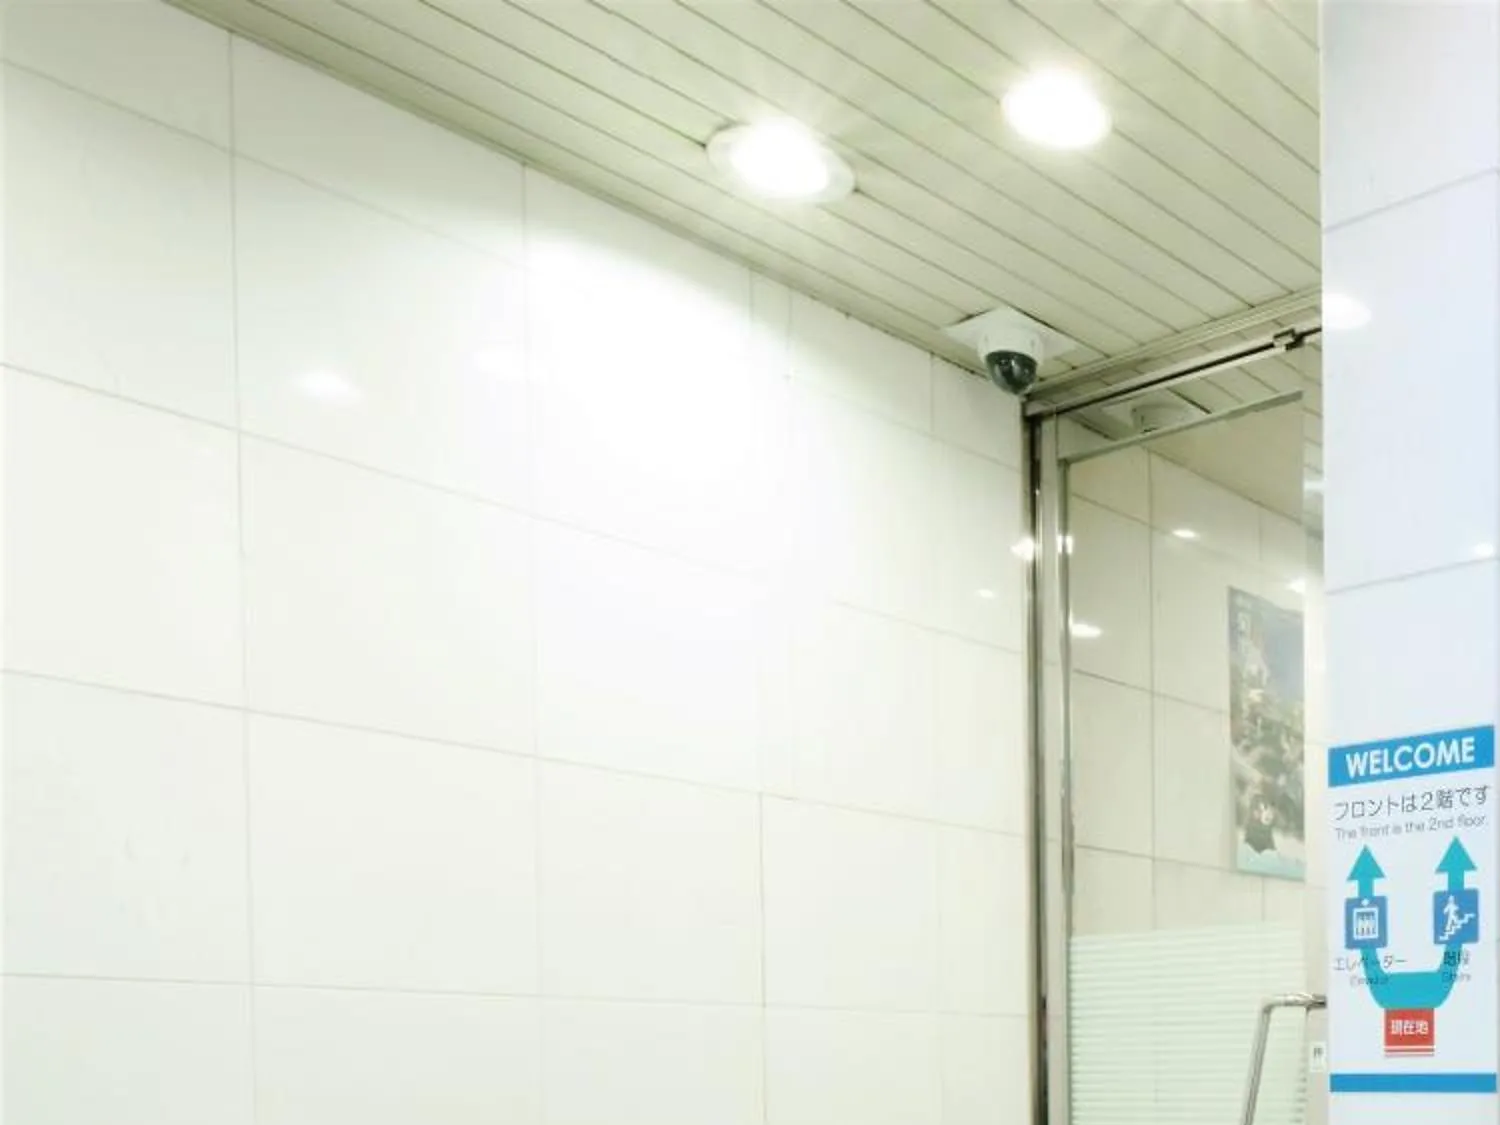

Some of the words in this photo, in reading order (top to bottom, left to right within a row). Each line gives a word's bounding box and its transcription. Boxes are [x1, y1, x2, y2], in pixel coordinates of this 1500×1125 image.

[1345, 736, 1476, 779] WELCOME
[1334, 785, 1492, 821] フロントは2階です
[1335, 826, 1357, 841] The
[1405, 820, 1425, 834] the
[1428, 816, 1454, 832] 2nd
